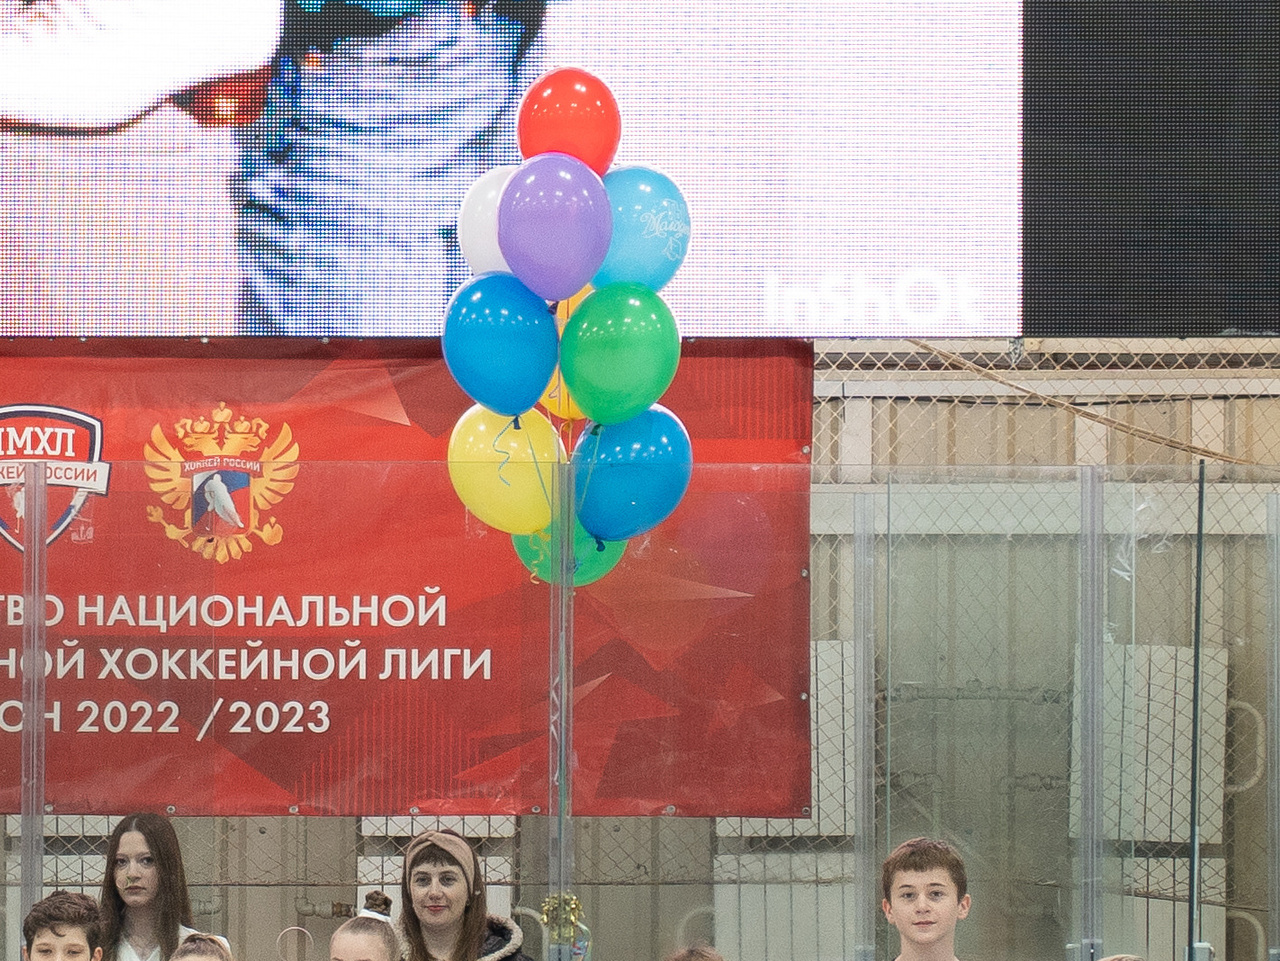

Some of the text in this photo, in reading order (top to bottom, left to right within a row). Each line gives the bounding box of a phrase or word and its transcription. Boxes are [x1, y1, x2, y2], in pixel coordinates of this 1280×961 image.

[45, 467, 97, 483] ОССИИ
[223, 457, 261, 472] РОССИИ
[78, 586, 447, 634] НАЦИОНАЛЬНОЙ
[98, 639, 367, 681] ХОККЕЙНОЙ
[378, 648, 492, 681] ЛИГИ
[76, 700, 180, 734] 2022
